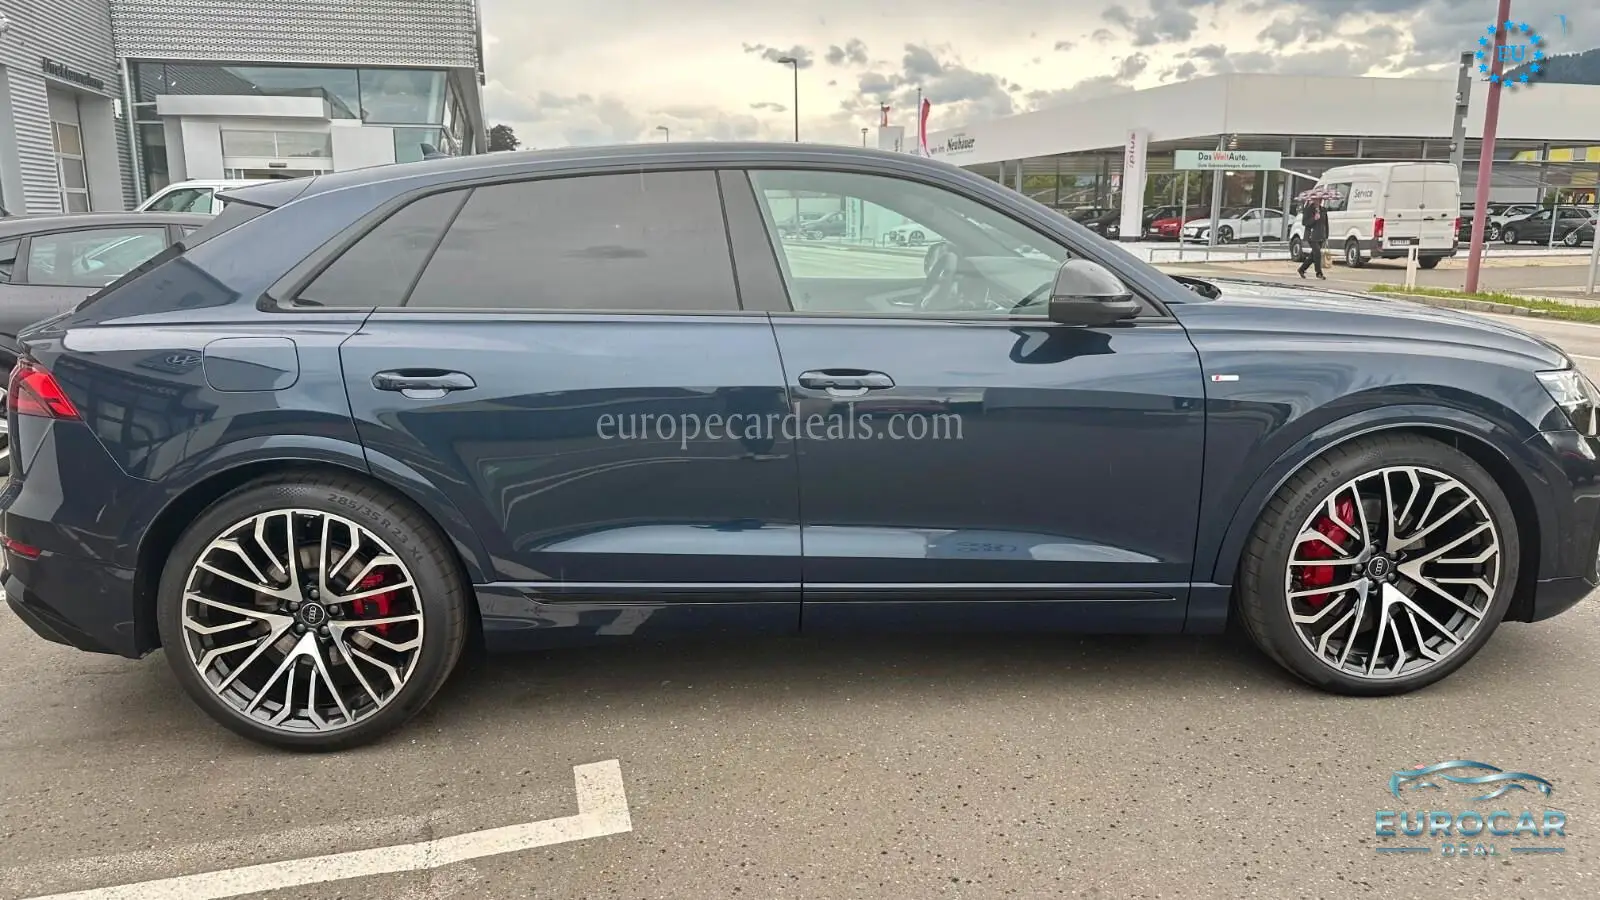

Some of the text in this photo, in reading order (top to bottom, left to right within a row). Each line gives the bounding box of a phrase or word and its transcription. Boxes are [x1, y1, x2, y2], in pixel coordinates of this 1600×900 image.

[1198, 152, 1212, 161] Das
[1353, 189, 1374, 199] Service
[327, 493, 425, 564] 285/35 R 23 XL
